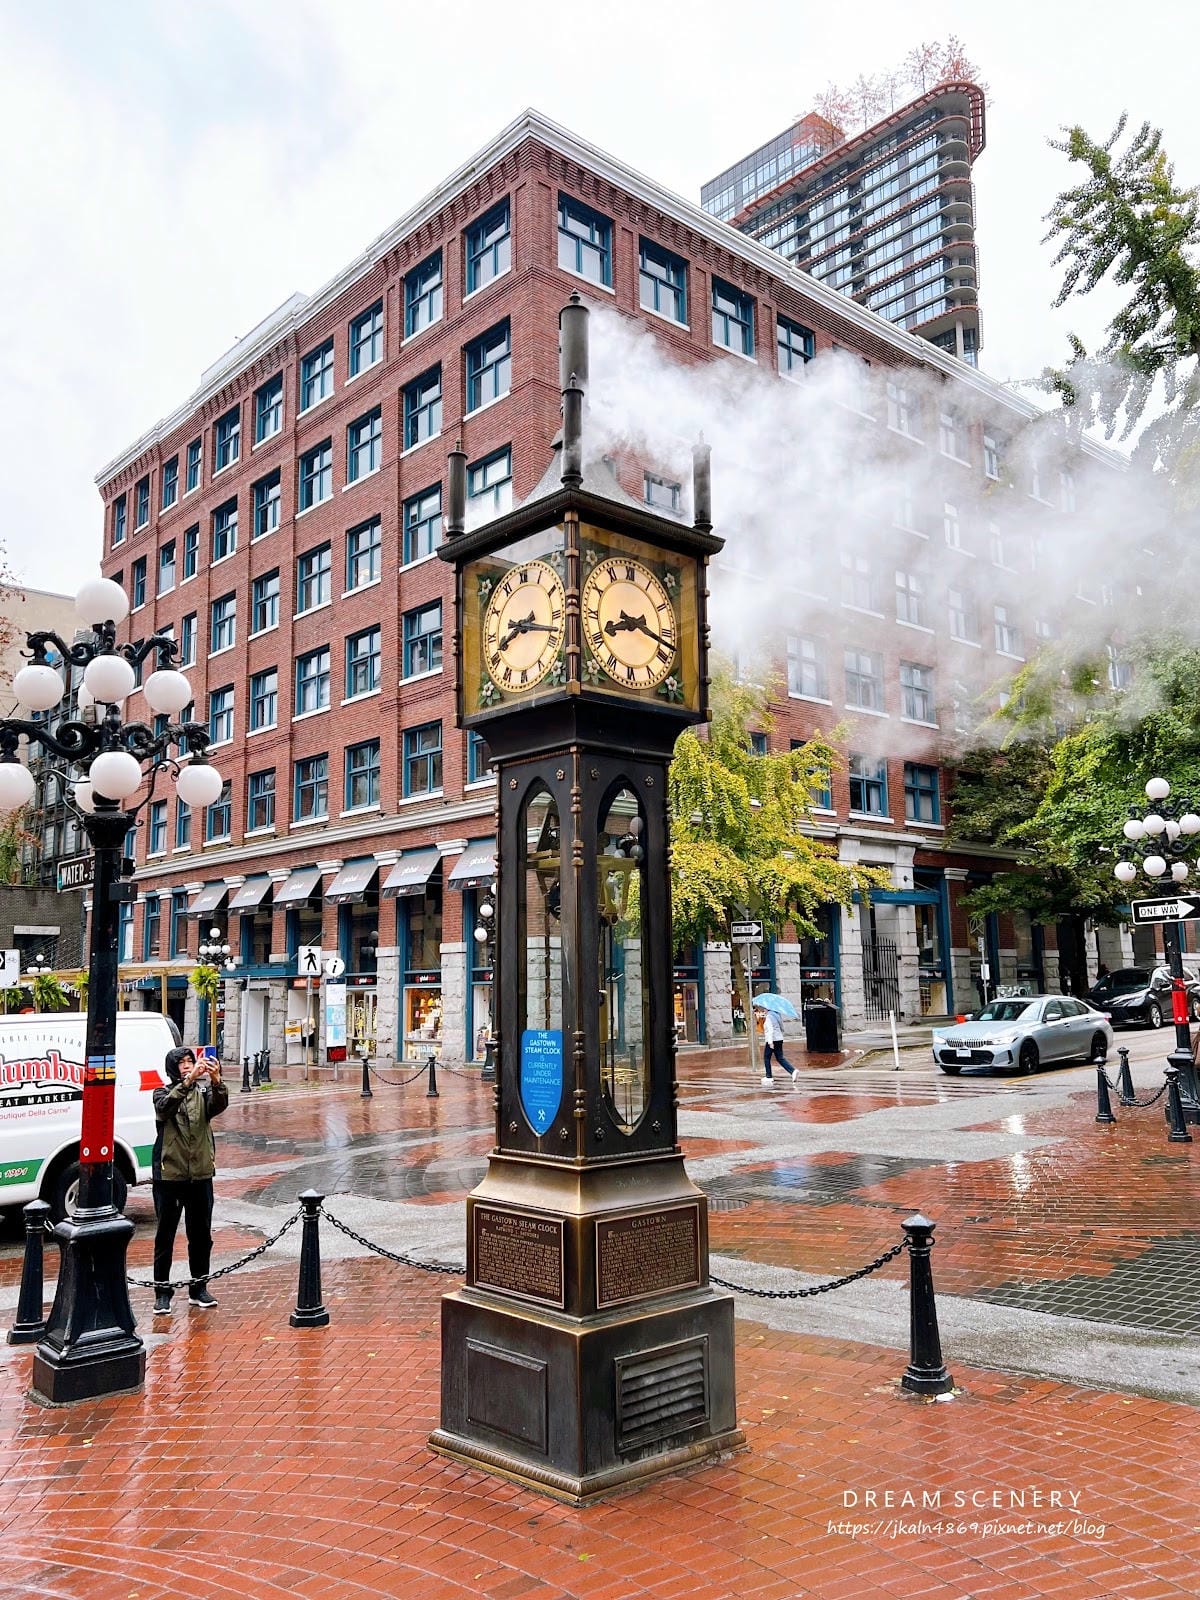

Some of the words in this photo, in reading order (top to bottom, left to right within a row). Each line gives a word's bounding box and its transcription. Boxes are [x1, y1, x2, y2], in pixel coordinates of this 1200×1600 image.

[607, 567, 617, 582] XI
[626, 566, 635, 581] XII
[503, 582, 512, 597] XI
[592, 582, 603, 597] X
[492, 607, 500, 616] X
[657, 603, 666, 612] II
[552, 610, 561, 620] III
[588, 608, 598, 620] IX
[488, 633, 496, 643] IX
[662, 629, 671, 638] III
[647, 666, 655, 679] V
[61, 863, 84, 886] WATER
[1140, 908, 1158, 916] ONE
[1161, 905, 1178, 914] WAY
[524, 1077, 560, 1086] MAINTENANCE
[28, 1093, 73, 1104] MARKET
[28, 1107, 45, 1117] Della
[480, 1212, 490, 1221] THE
[492, 1216, 518, 1226] GASTOWN
[519, 1220, 536, 1230] STEAM
[538, 1224, 558, 1234] CLOCK
[632, 1216, 666, 1228] GASTOWN
